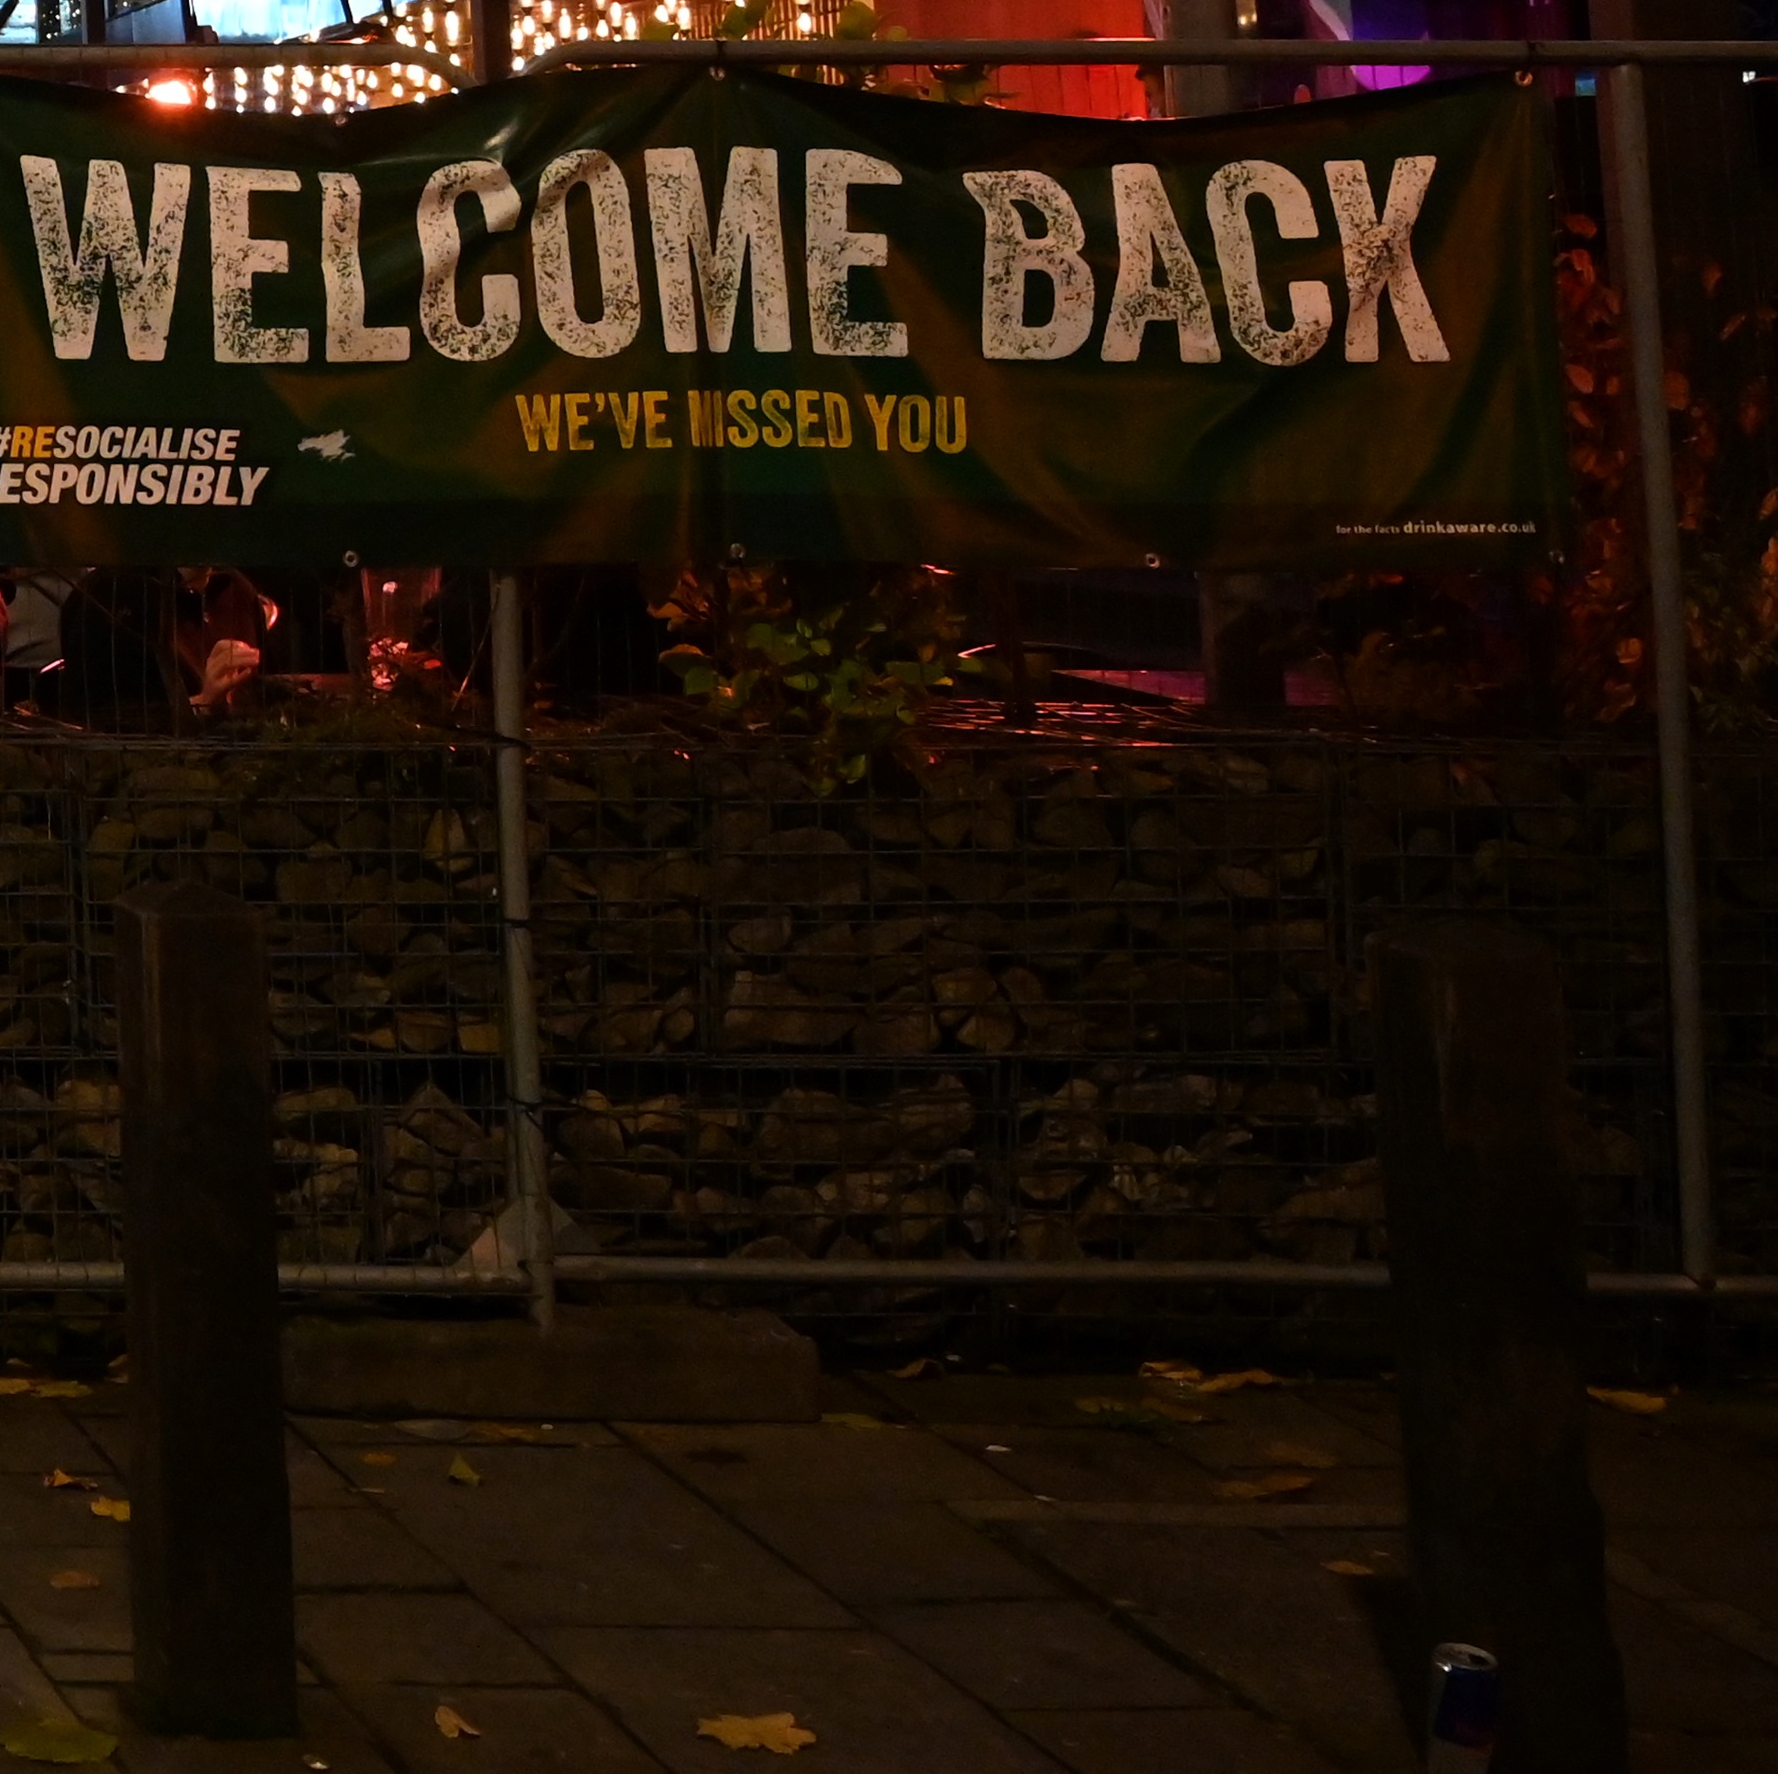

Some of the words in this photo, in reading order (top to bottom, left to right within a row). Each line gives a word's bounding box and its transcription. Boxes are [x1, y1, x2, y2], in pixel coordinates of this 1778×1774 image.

[18, 147, 908, 363] WELCOME
[962, 155, 1449, 367] BACK
[515, 390, 672, 454] WE'VE
[688, 391, 851, 452] MISSED
[863, 391, 967, 456] YOU
[1336, 525, 1353, 534] for
[1354, 525, 1372, 534] the
[1375, 524, 1400, 534] facts
[1403, 521, 1537, 534] drinkaware.co.uk
